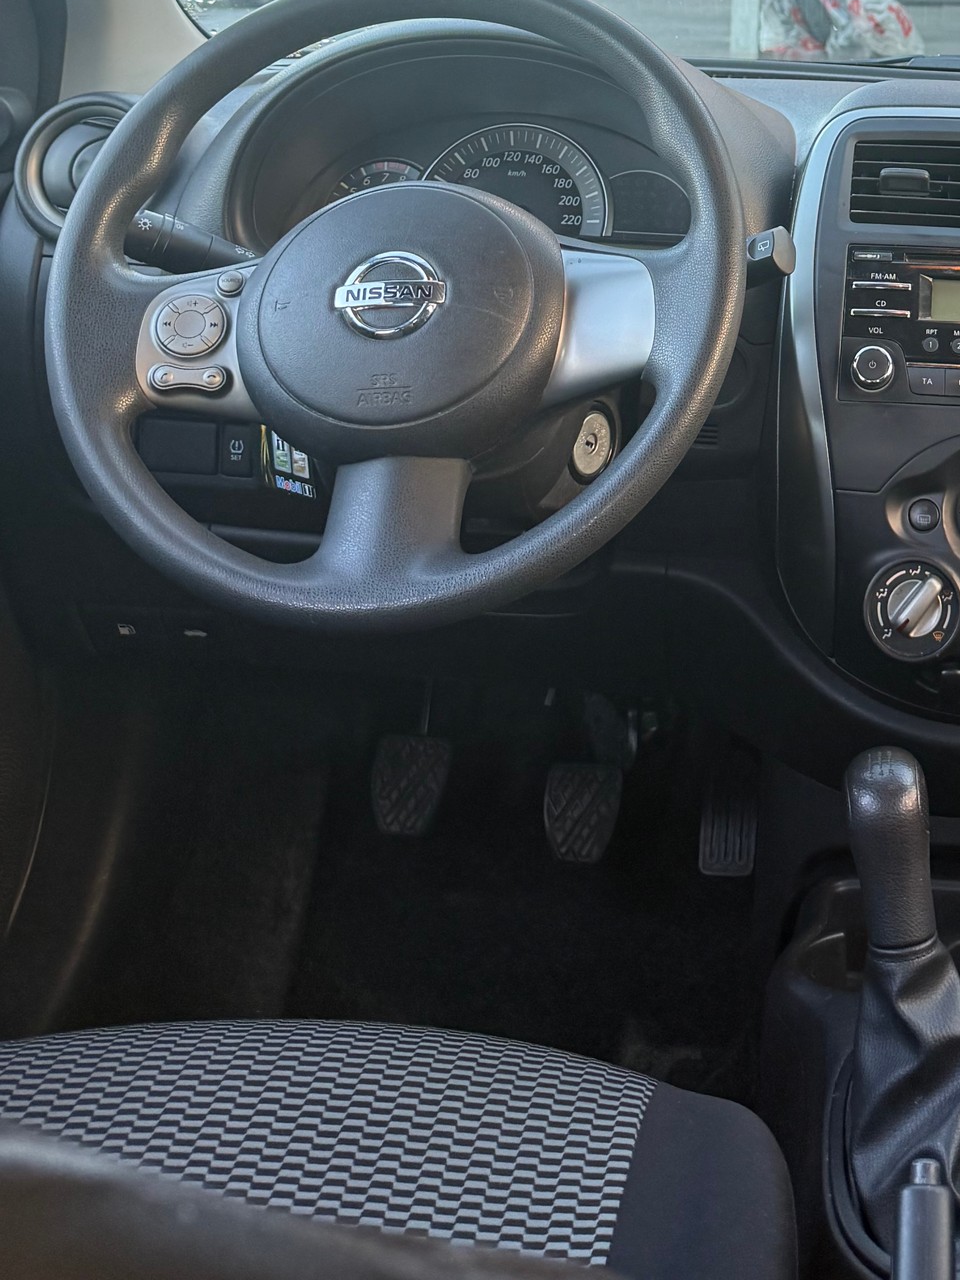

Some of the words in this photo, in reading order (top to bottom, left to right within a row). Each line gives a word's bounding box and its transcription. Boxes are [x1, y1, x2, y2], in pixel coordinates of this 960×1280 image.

[503, 151, 522, 162] 120
[524, 154, 543, 165] 140
[481, 157, 501, 168] 100
[463, 167, 480, 179] 80
[507, 169, 527, 177] km/h
[541, 164, 560, 175] 160
[363, 176, 372, 186] 6
[382, 172, 390, 183] 7
[553, 178, 573, 189] 180
[558, 195, 580, 206] 200
[560, 214, 581, 225] 220
[345, 284, 433, 302] NISSAN
[875, 299, 887, 307] CD
[371, 373, 398, 387] SRS
[922, 378, 933, 386] TA
[357, 390, 412, 407] AIRBAG
[276, 475, 302, 495] Mobil
